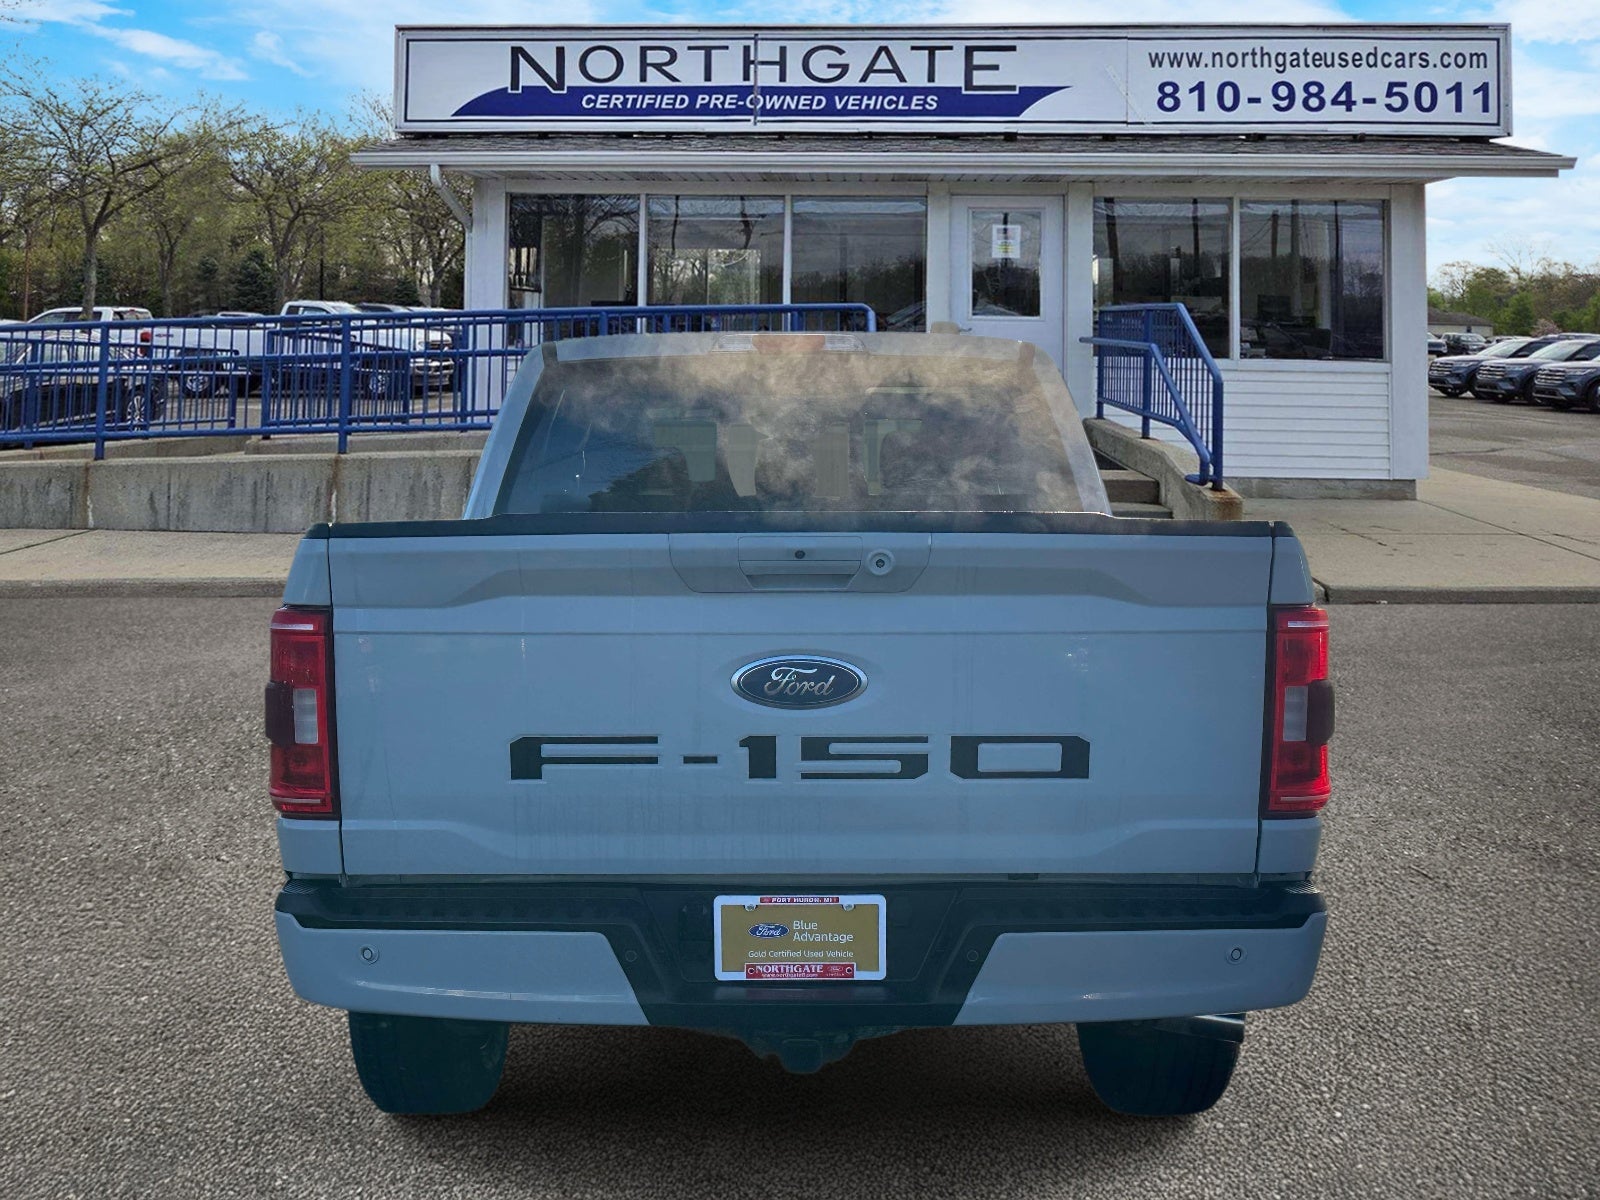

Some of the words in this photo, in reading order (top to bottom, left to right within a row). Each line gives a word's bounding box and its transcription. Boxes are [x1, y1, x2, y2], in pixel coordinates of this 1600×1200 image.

[509, 44, 1017, 92] NORTHGATE
[1148, 46, 1488, 73] www.northgateusedcars.com
[581, 94, 689, 110] CERTIFIED
[695, 94, 827, 111] PRE-OWNED
[835, 95, 939, 111] VEHICLES
[1156, 80, 1491, 113] 810-984-5011
[764, 666, 836, 696] Ford
[509, 735, 1091, 780] F-150
[756, 924, 782, 936] Ford
[793, 920, 818, 930] Blue
[793, 932, 854, 944] Advantage
[748, 950, 767, 958] Gold
[769, 949, 802, 958] Certified
[803, 950, 824, 958] Used
[826, 950, 854, 958] Vehicle
[755, 964, 824, 973] NORTHGATE
